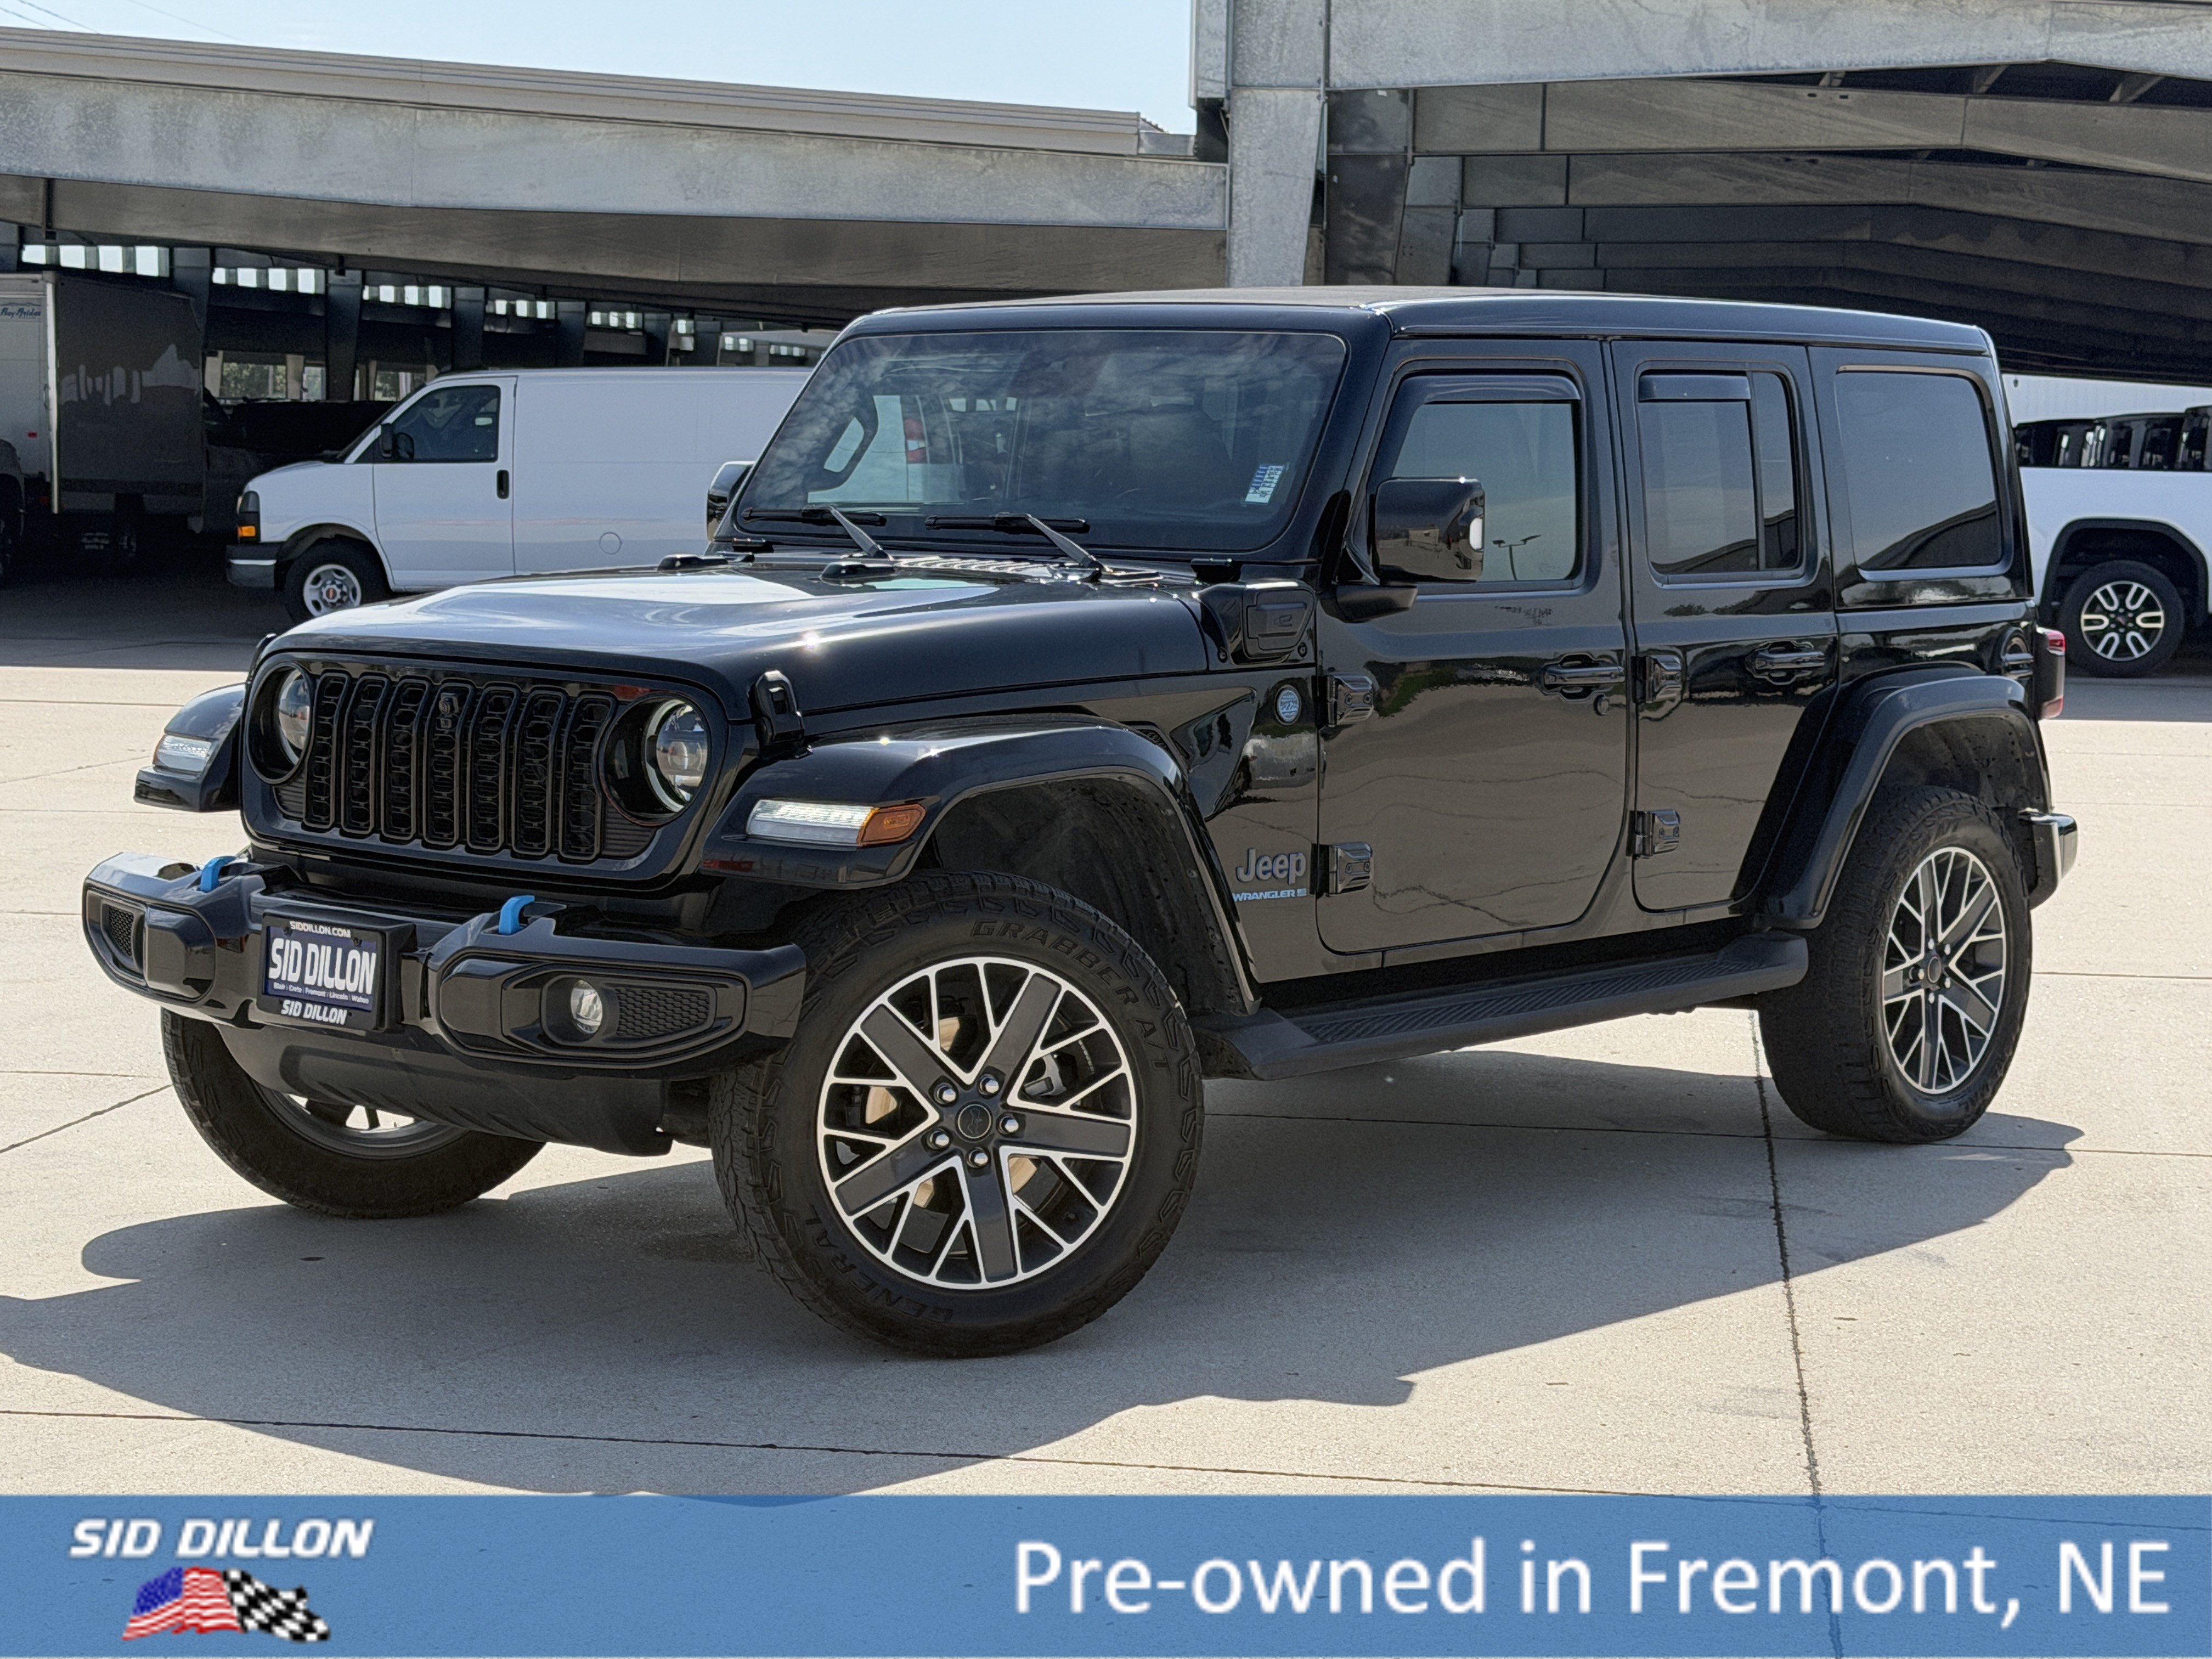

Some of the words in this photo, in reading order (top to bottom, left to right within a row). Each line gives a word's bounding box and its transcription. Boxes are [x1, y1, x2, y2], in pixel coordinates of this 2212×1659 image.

[1235, 848, 1306, 885] Jeep
[1232, 889, 1295, 902] WRANGLER
[289, 920, 352, 938] SIDDILLON.COM
[268, 938, 302, 983] SID
[304, 943, 377, 995] DILLON
[972, 920, 1139, 1005] GRABBER
[281, 1000, 302, 1017] SID
[303, 1003, 348, 1025] DILLON
[805, 1205, 954, 1324] GENERAL
